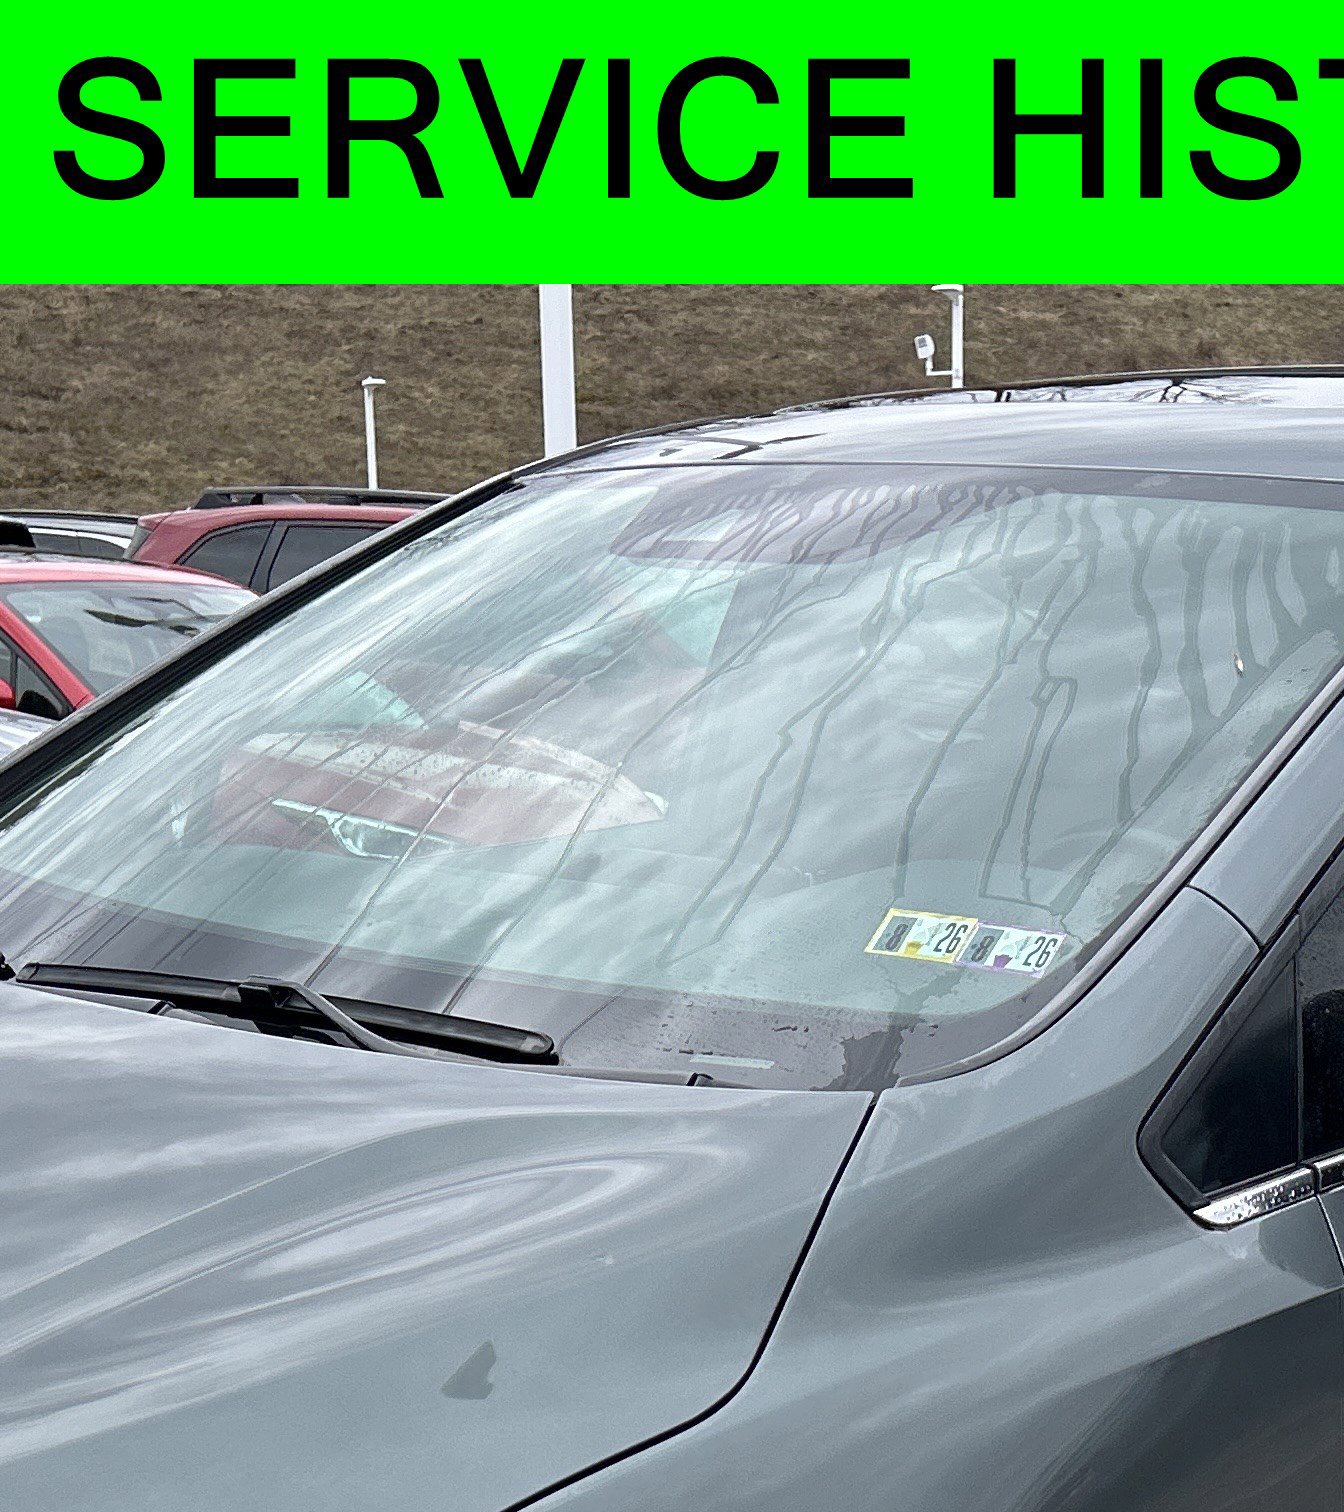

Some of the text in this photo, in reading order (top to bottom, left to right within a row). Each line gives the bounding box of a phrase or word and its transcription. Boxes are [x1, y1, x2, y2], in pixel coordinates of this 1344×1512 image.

[884, 921, 969, 954] 8 26
[970, 935, 1058, 968] 8 26
